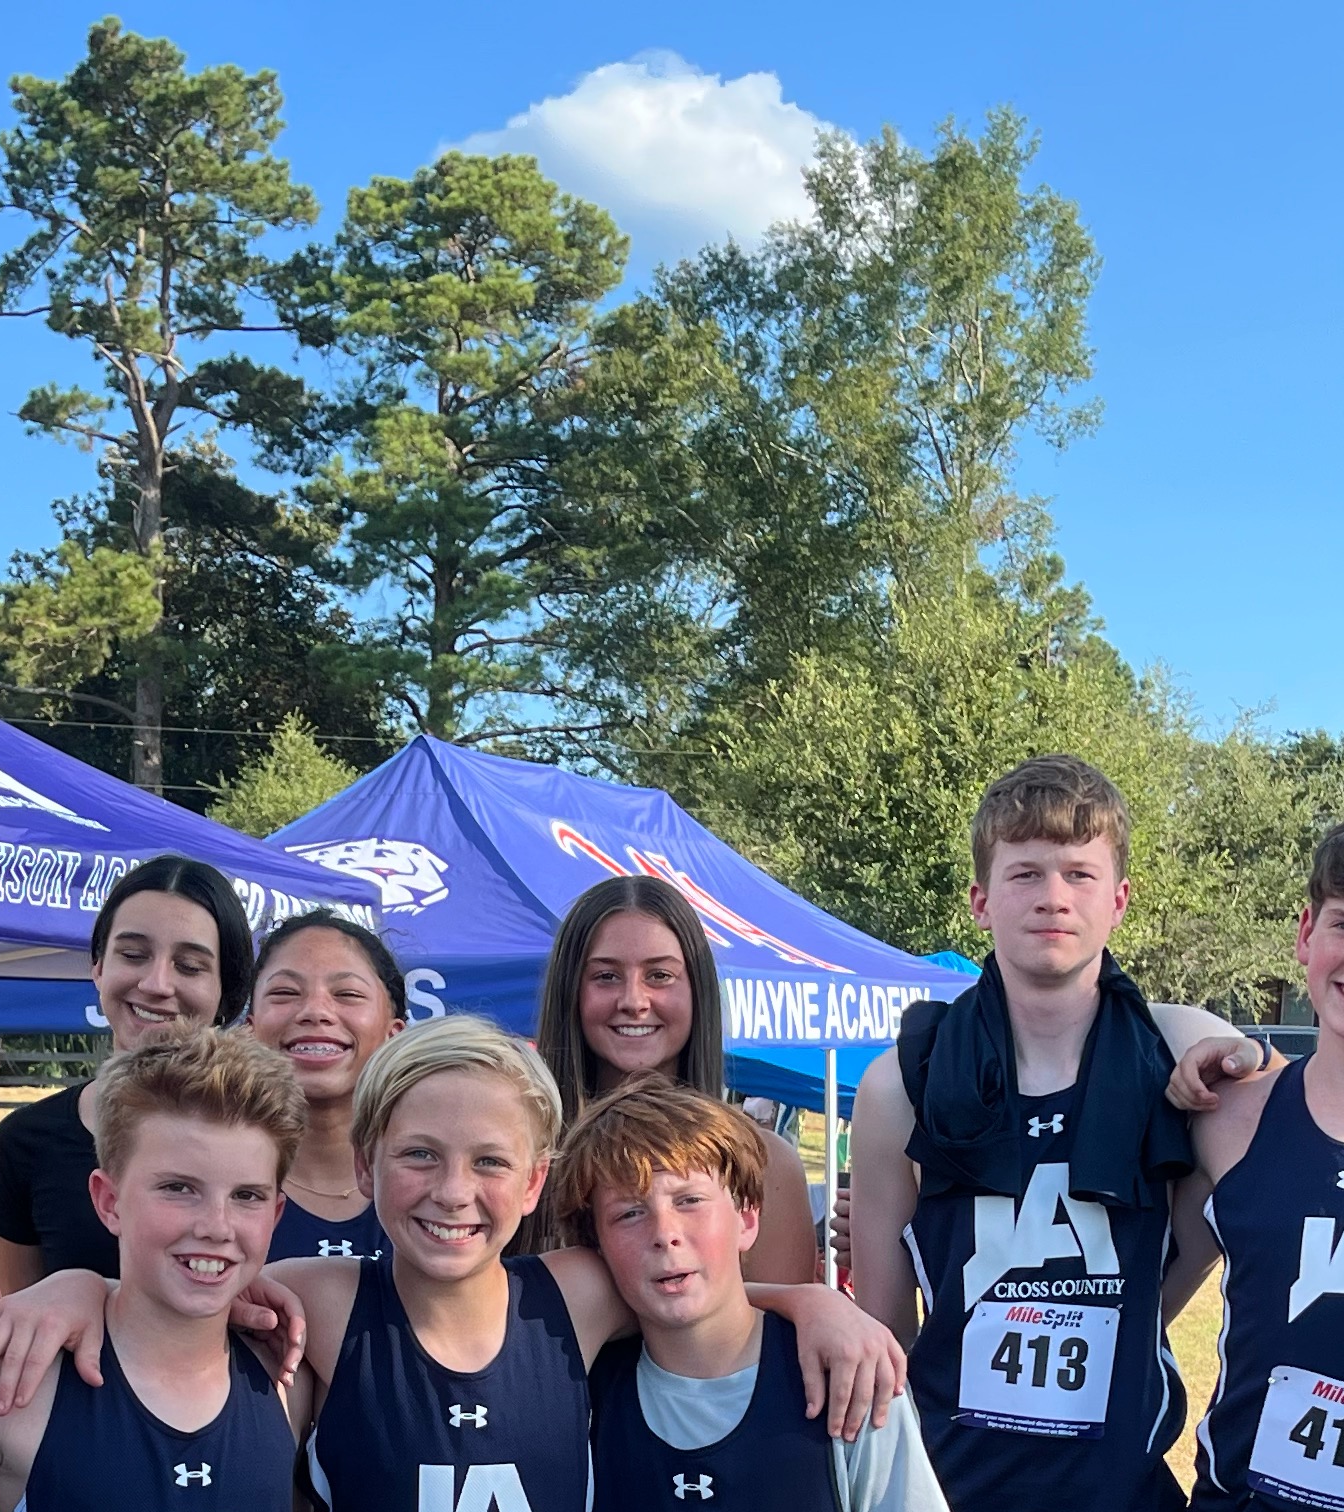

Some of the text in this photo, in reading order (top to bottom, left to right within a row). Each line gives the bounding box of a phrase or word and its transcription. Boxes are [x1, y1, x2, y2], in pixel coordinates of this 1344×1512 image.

[725, 978, 930, 1039] WAYNE ACADE
[963, 1162, 1120, 1312] JA
[994, 1278, 1125, 1299] CROSS COUNTRY
[1005, 1306, 1084, 1330] MileSplit
[991, 1331, 1089, 1392] 413
